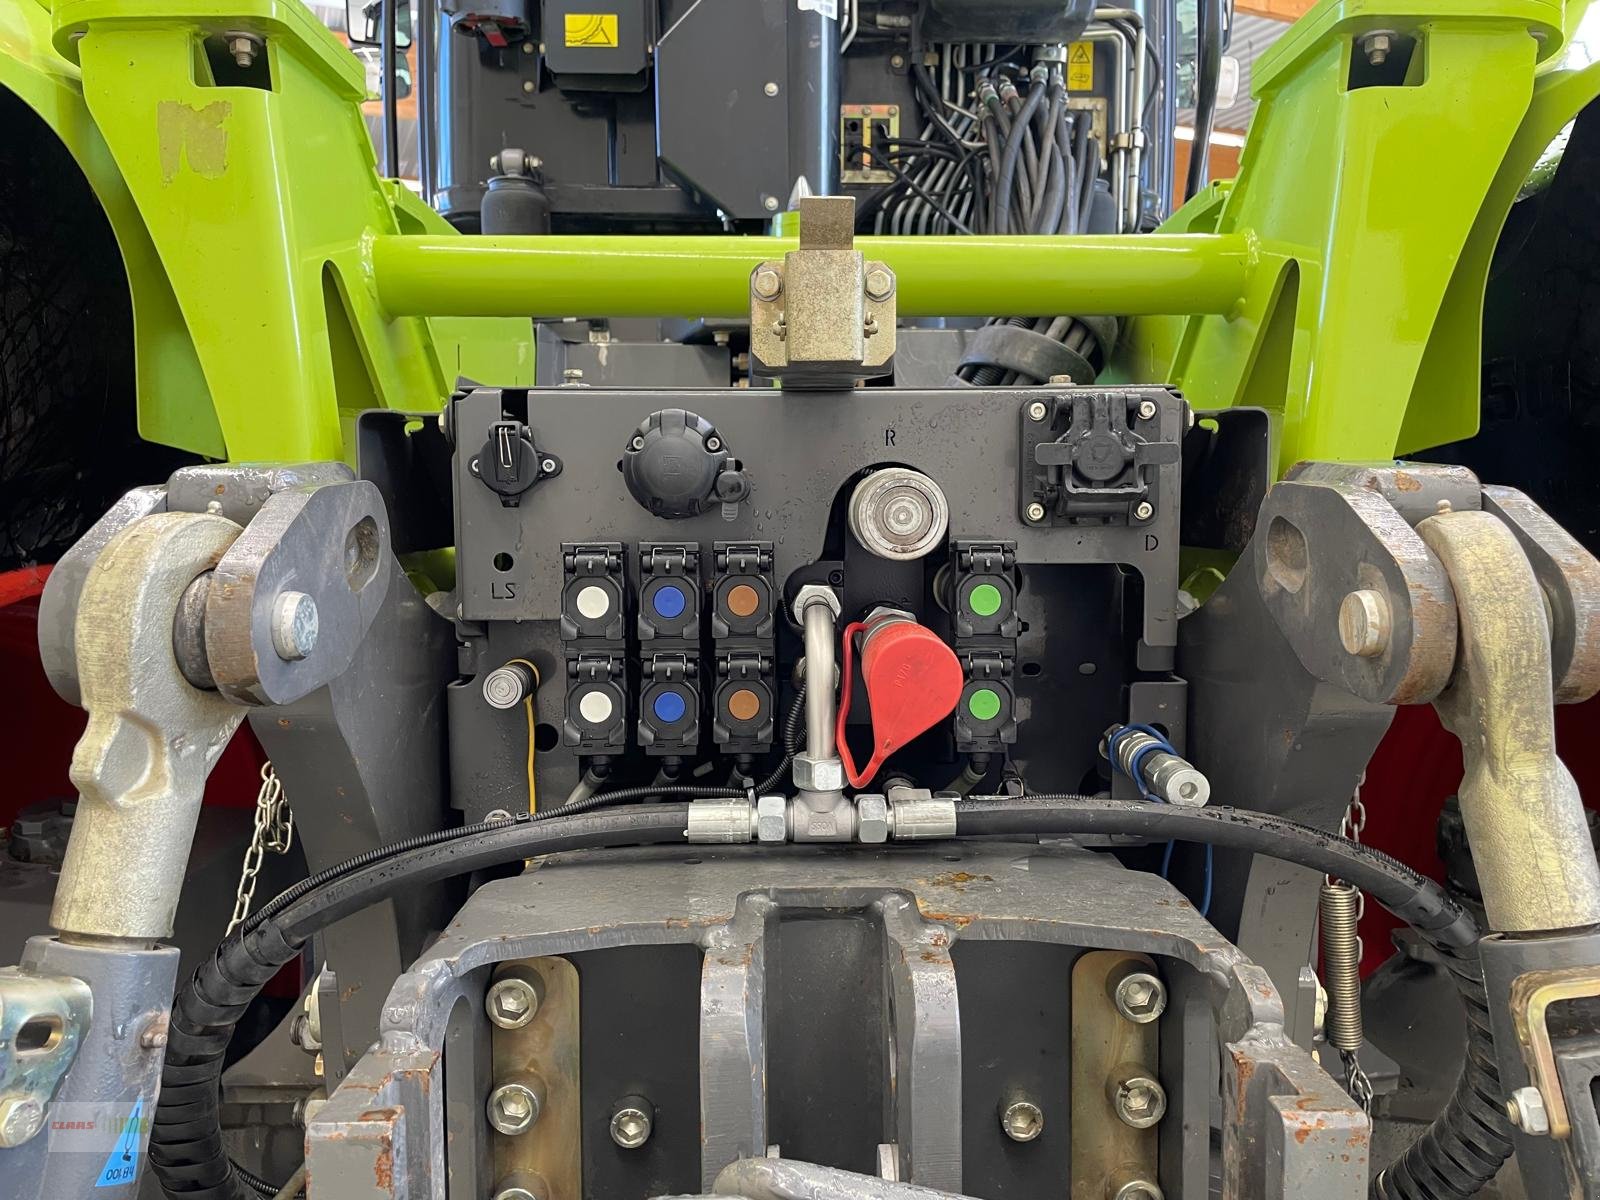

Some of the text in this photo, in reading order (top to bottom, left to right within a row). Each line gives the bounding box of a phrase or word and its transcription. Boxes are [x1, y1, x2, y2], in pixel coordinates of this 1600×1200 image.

[885, 429, 896, 447] R
[1145, 534, 1159, 551] D
[491, 582, 516, 600] LS
